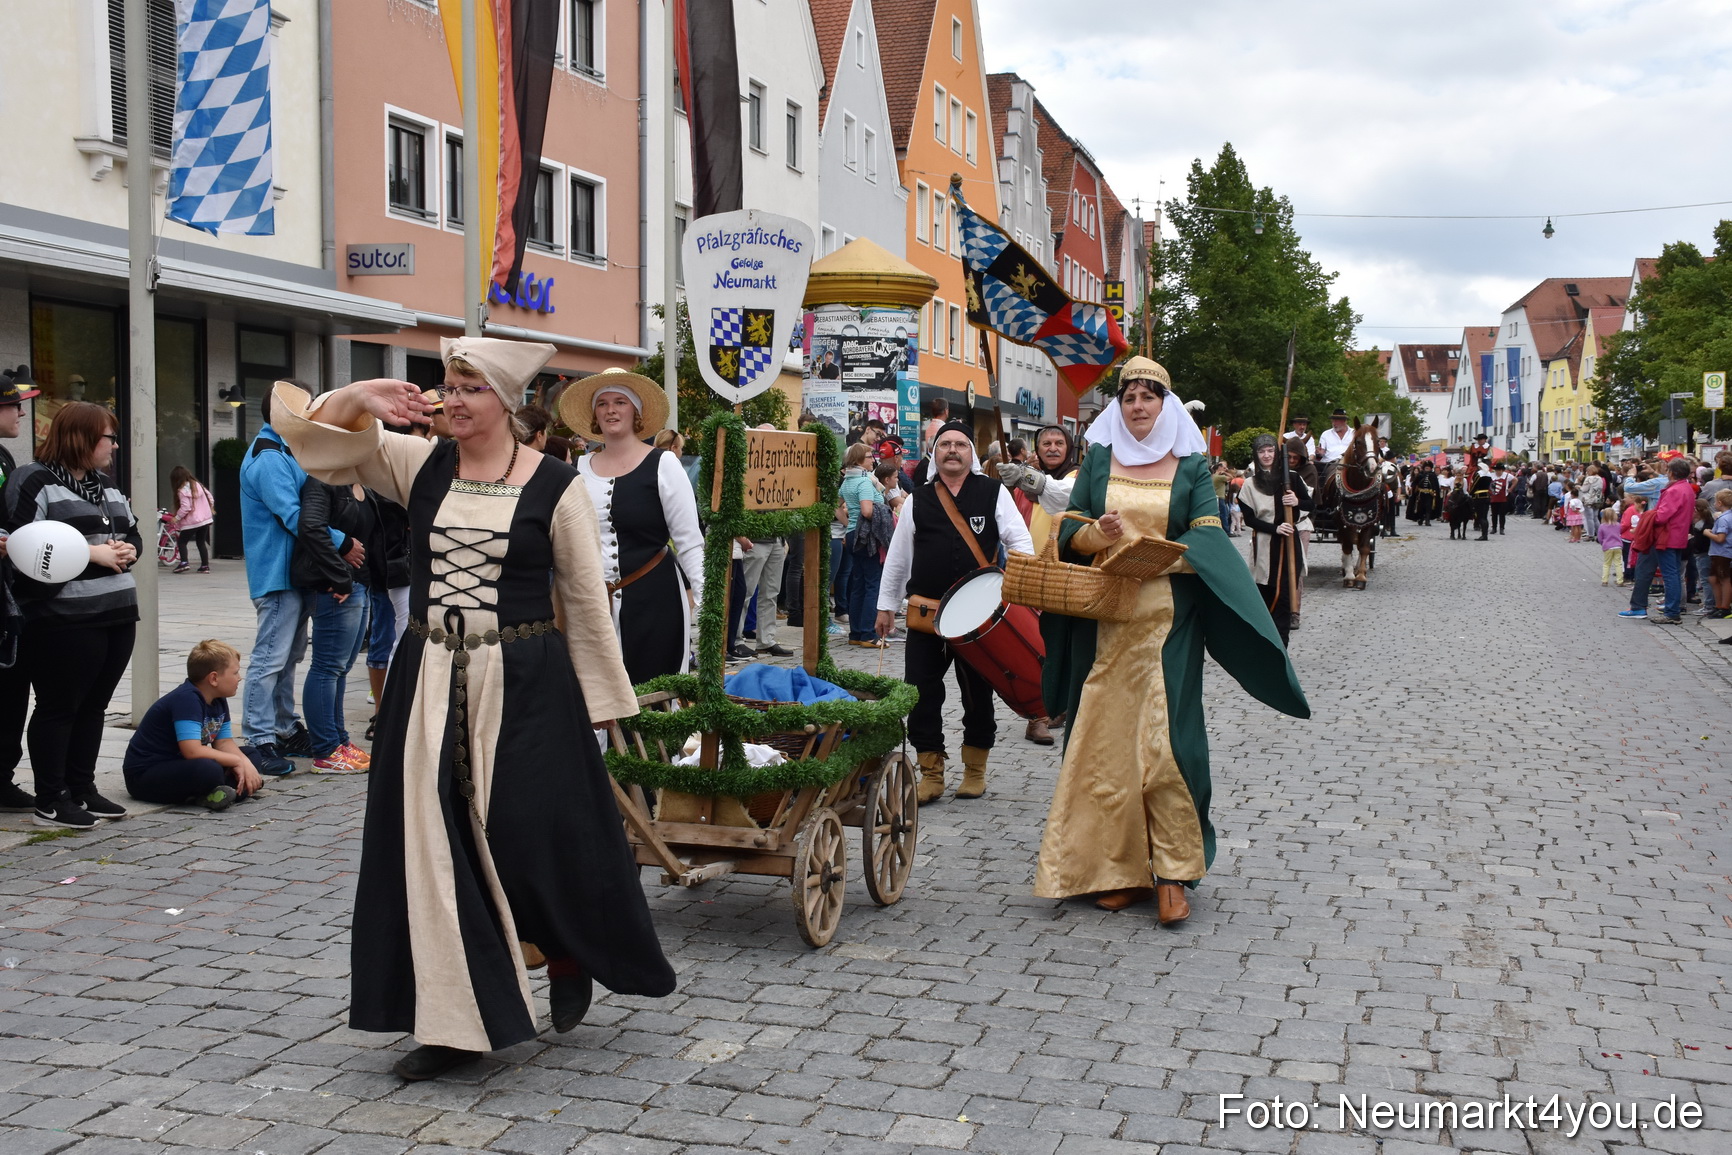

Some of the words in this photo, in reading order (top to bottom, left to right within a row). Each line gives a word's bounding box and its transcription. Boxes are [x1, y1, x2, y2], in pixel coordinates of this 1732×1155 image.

[697, 227, 802, 254] Pfalzgräfisches
[349, 248, 406, 268] sutor.
[731, 257, 764, 270] Gefolge
[713, 270, 777, 289] Neumarkt
[748, 436, 818, 475] falzgräfische
[756, 476, 795, 507] Gefolge
